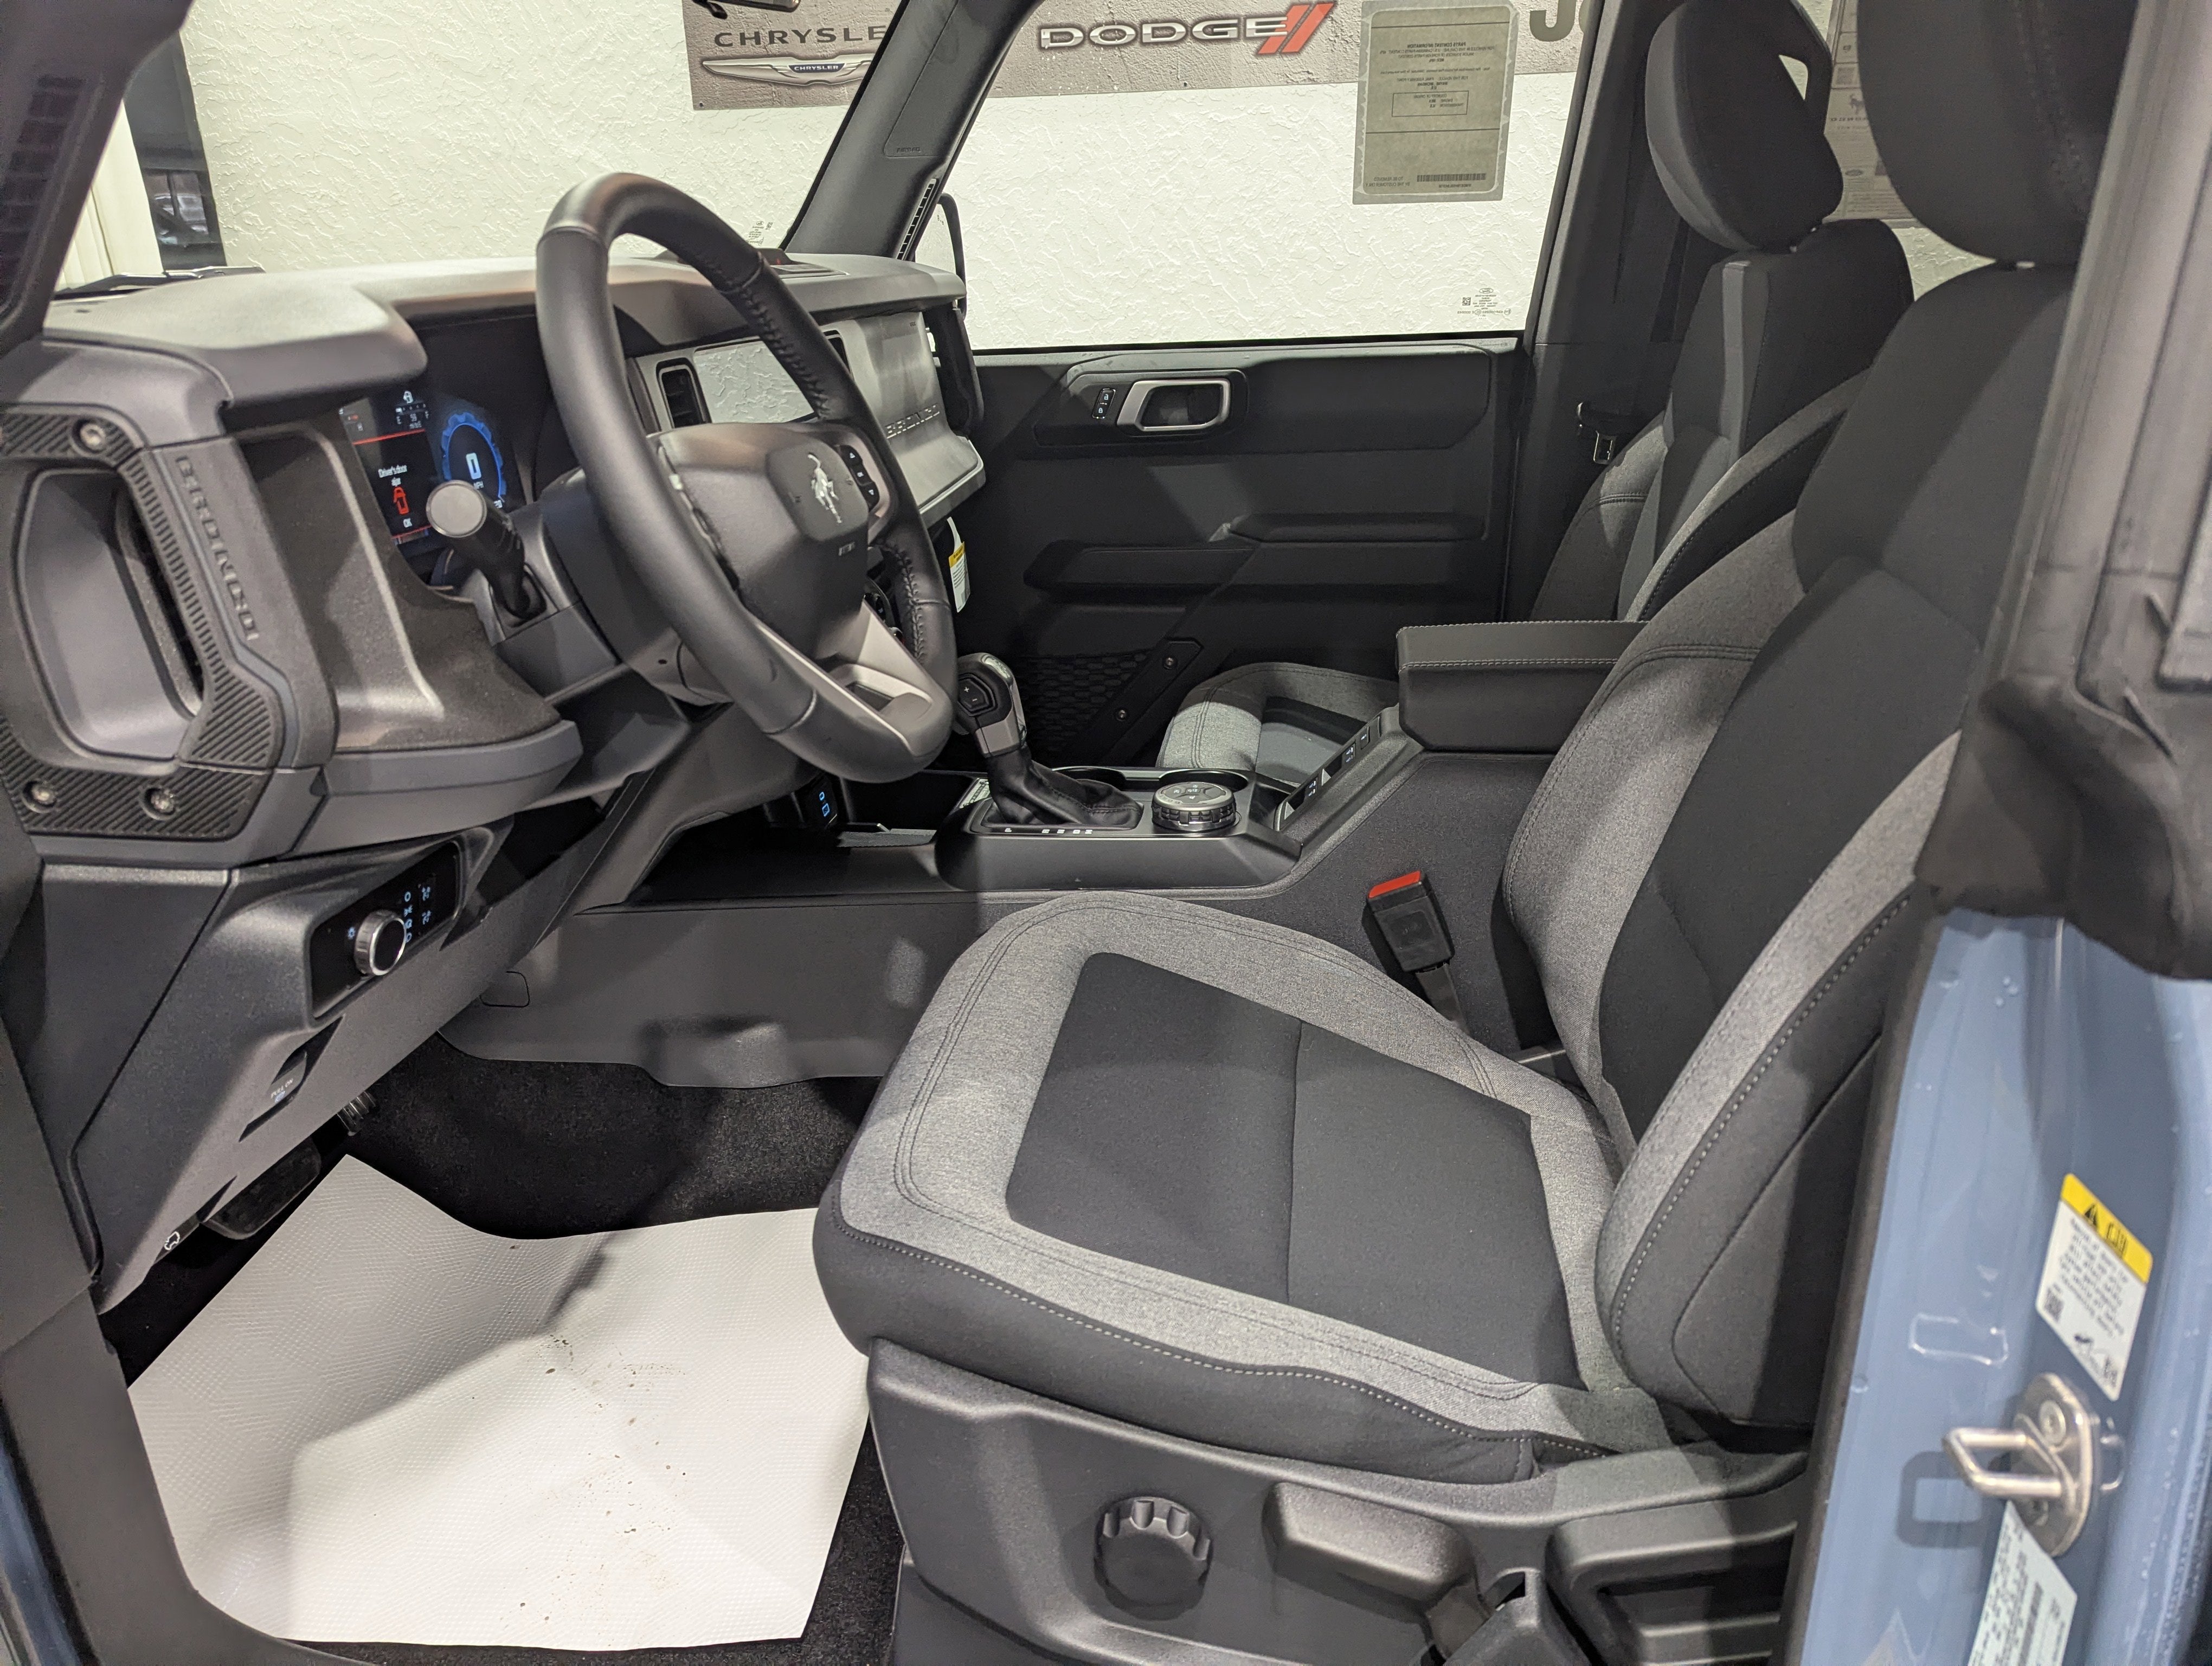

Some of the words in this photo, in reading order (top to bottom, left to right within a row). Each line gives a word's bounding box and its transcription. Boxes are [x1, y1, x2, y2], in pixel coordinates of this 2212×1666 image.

[714, 25, 886, 47] CHRYSLE
[1040, 16, 1288, 48] DODGE
[885, 402, 941, 440] BRONCO
[175, 456, 260, 642] BRONCO
